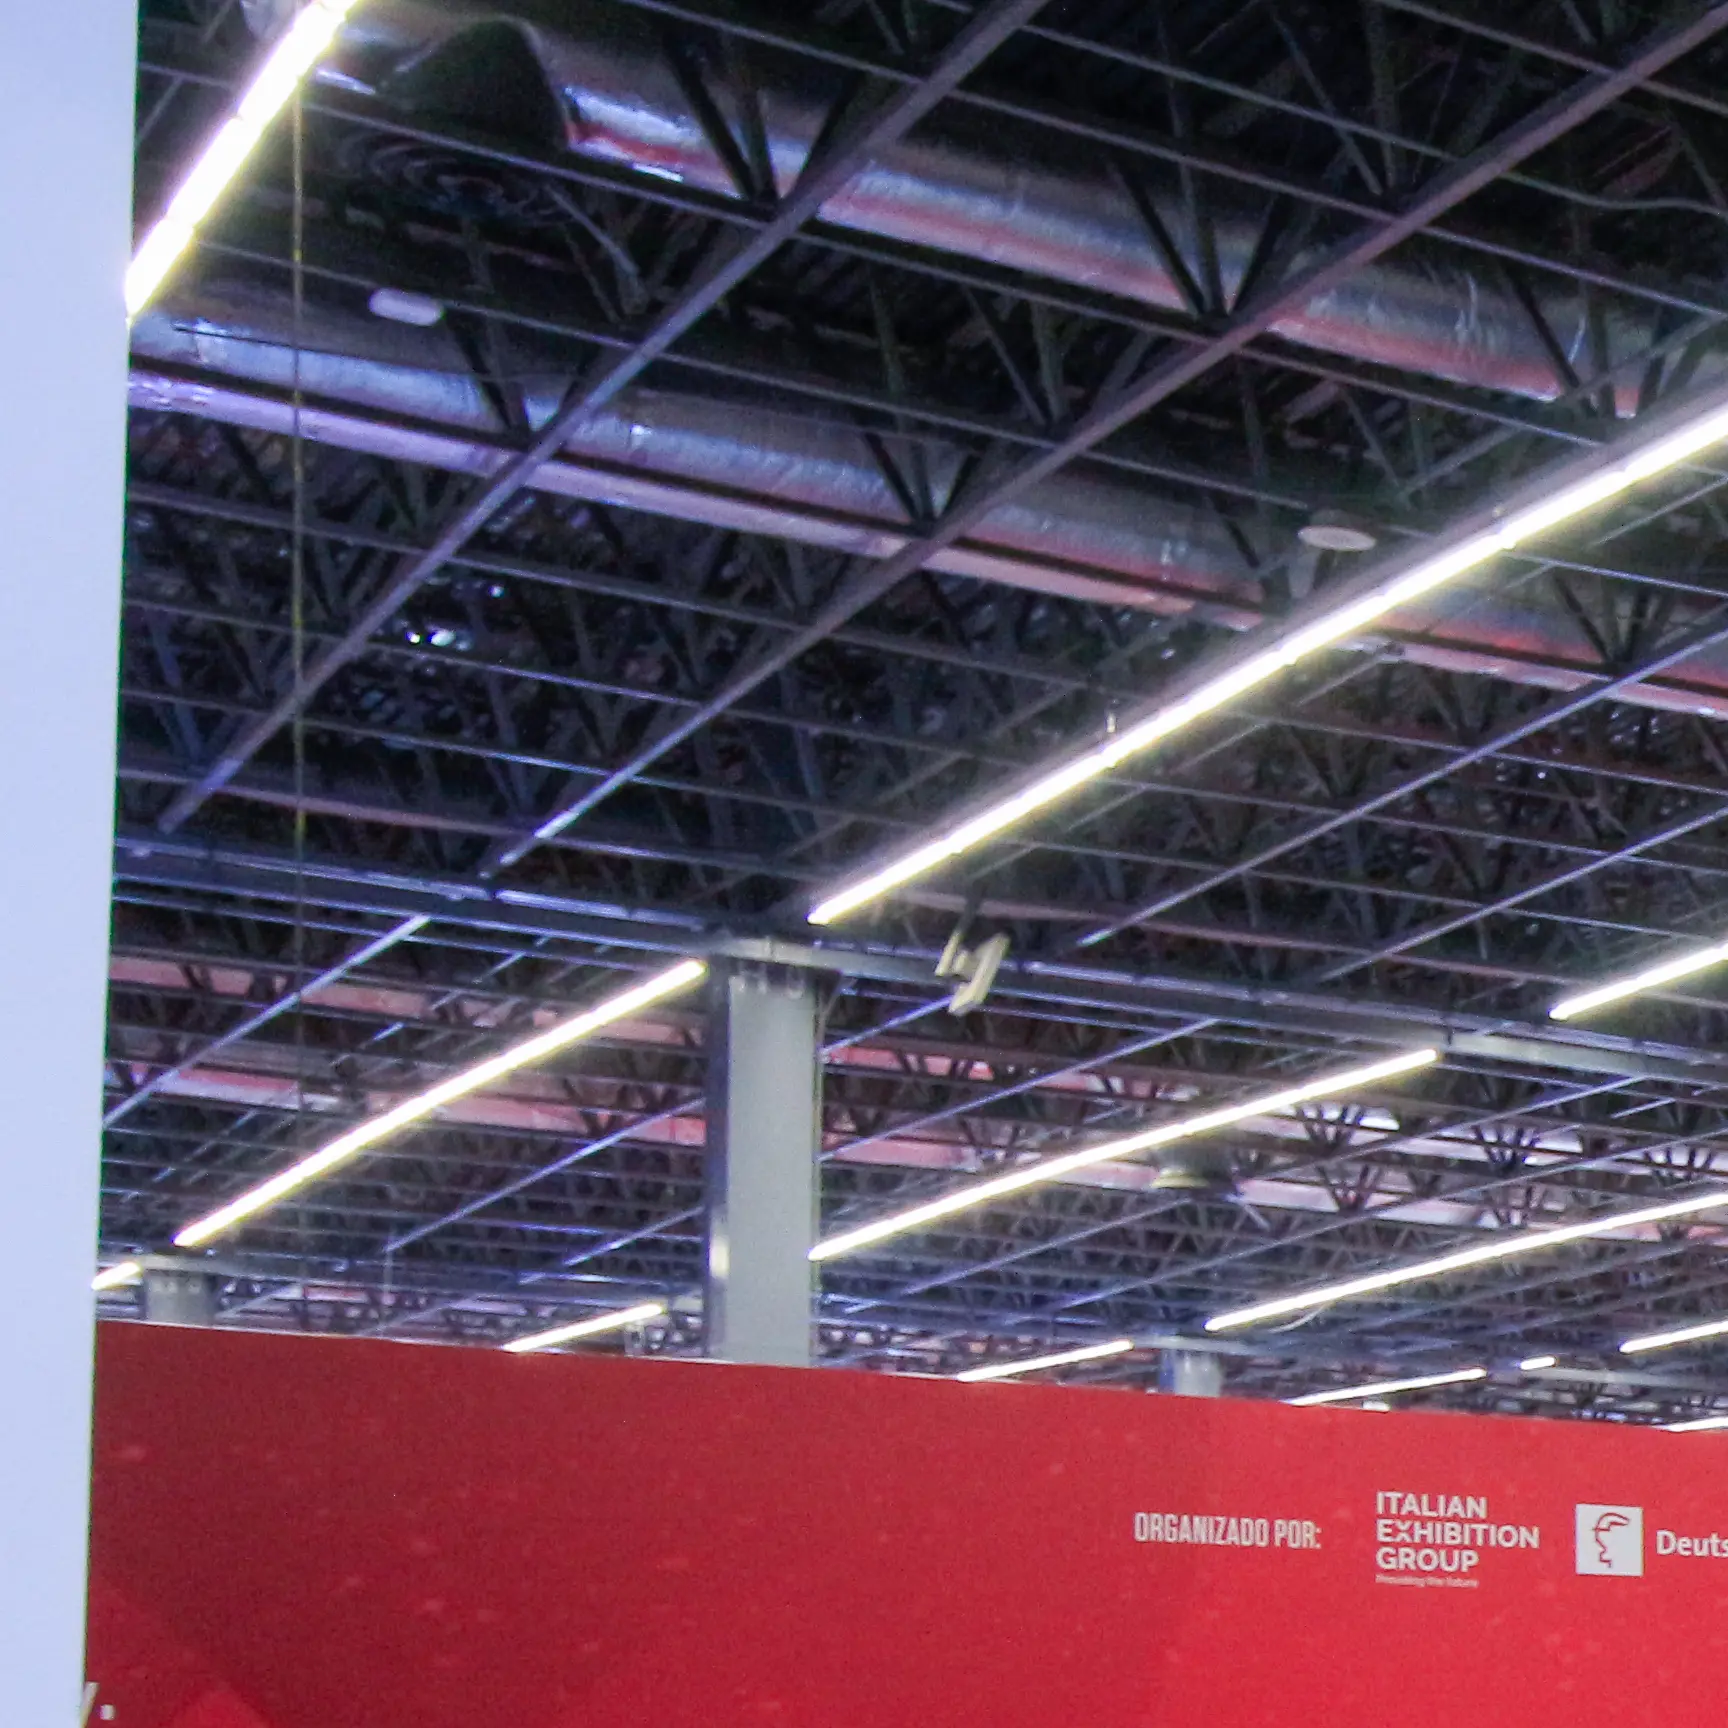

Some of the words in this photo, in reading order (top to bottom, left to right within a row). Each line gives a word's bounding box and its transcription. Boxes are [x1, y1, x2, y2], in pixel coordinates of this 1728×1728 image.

[1376, 1491, 1487, 1519] ITALIAN
[1134, 1512, 1270, 1547] ORGANIZADO
[1273, 1518, 1322, 1549] POR:
[1376, 1519, 1540, 1548] EXHIBITION
[1376, 1546, 1480, 1573] GROUP
